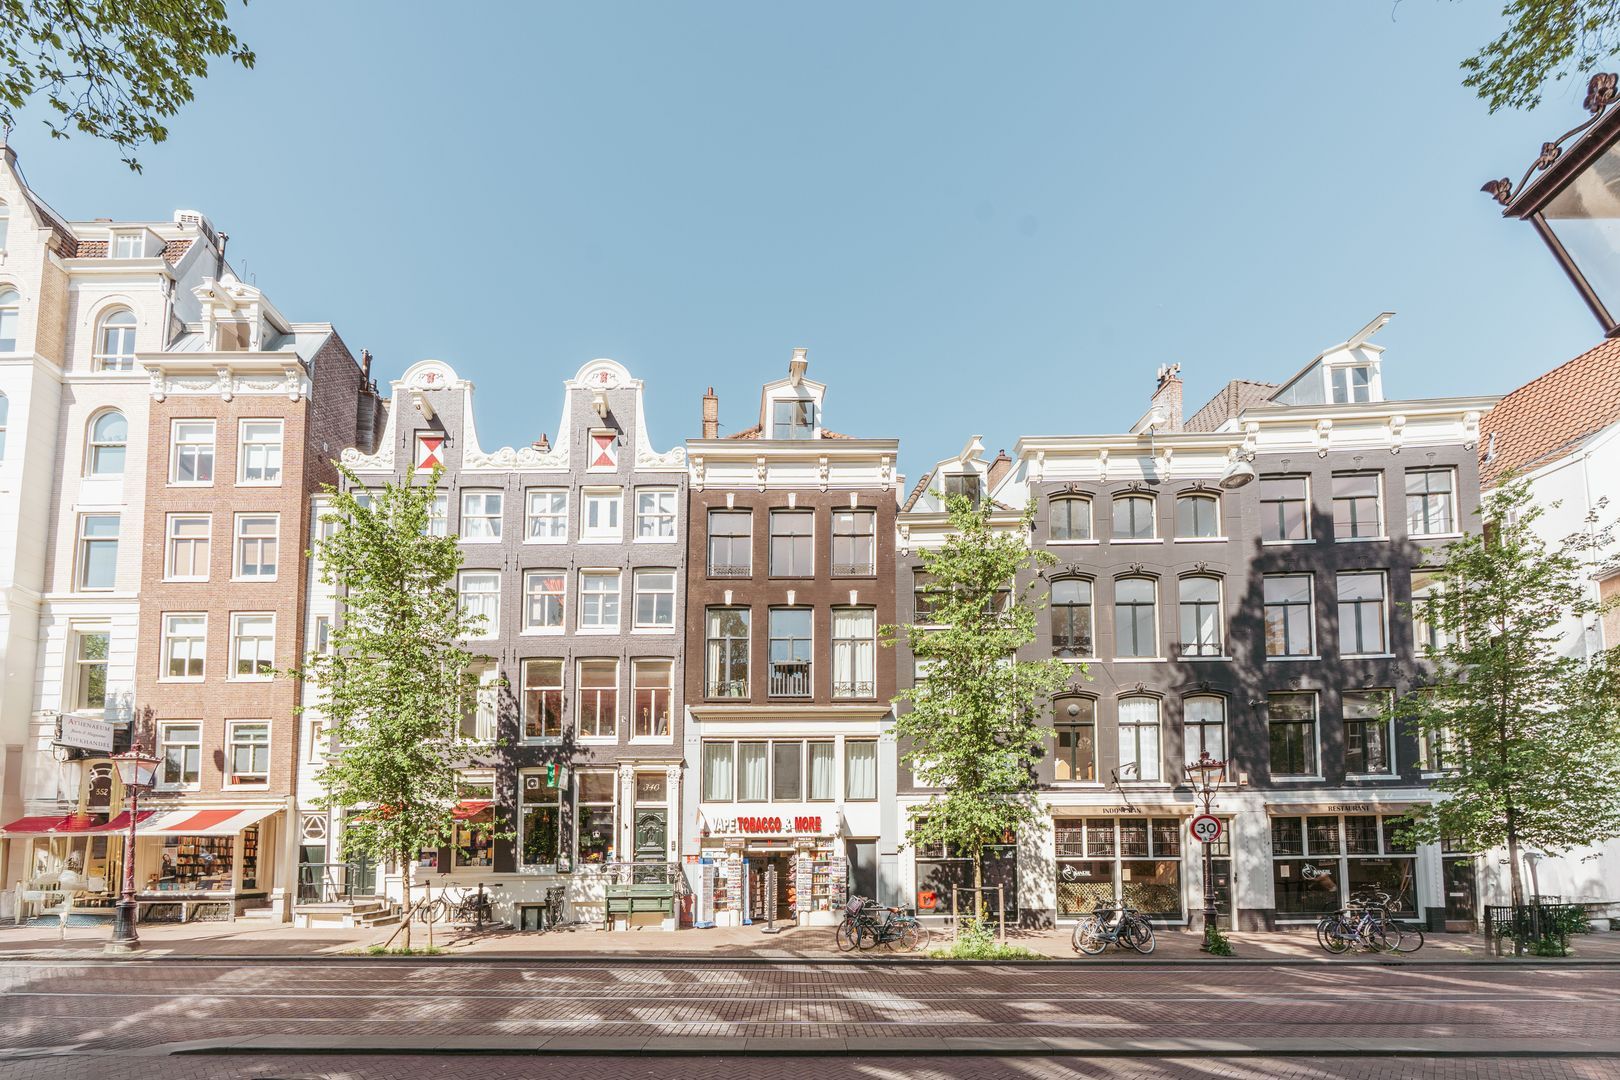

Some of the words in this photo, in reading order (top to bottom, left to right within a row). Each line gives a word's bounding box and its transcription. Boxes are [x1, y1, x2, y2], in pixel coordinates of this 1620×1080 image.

[68, 718, 110, 731] ATHENAEUM
[95, 788, 108, 796] 352
[642, 783, 660, 791] 340
[713, 817, 737, 834] VAPE
[737, 815, 782, 834] TOBACCO
[785, 817, 793, 833] &
[795, 815, 822, 834] MORE
[1196, 822, 1217, 834] 30
